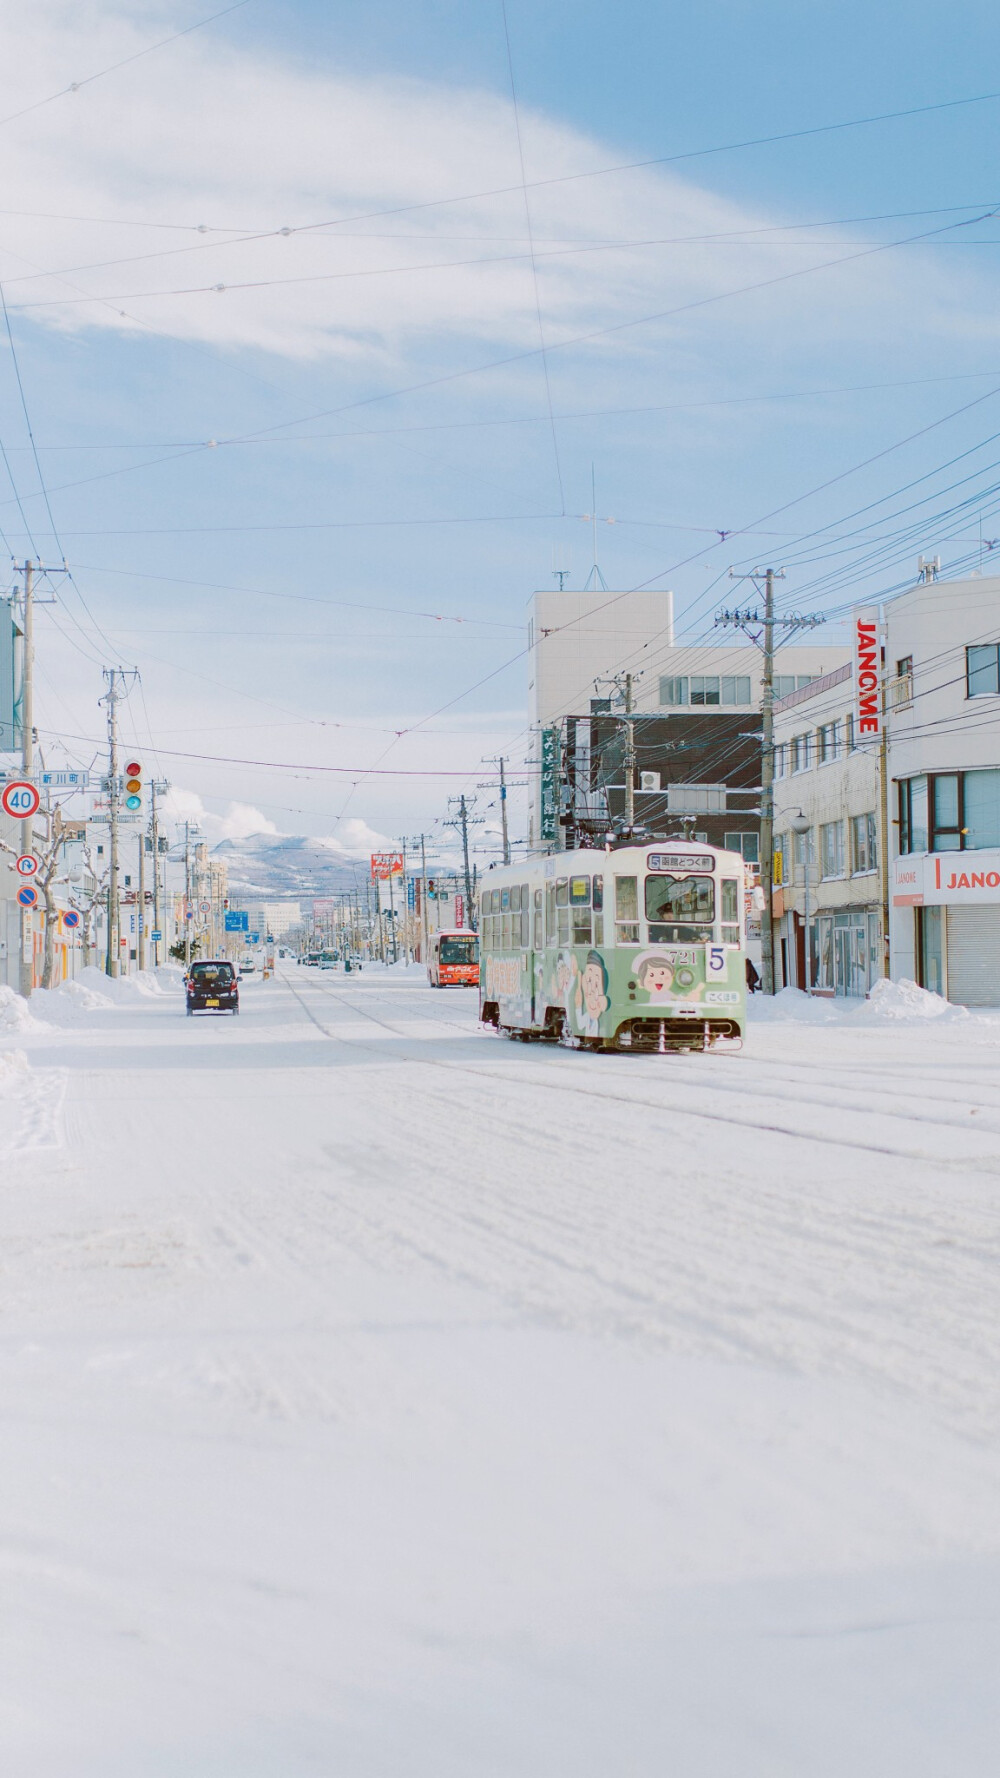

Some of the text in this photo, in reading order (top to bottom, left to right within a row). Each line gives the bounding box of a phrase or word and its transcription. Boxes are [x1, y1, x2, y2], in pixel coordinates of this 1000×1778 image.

[857, 618, 878, 733] JANOME
[10, 792, 31, 808] 40
[651, 856, 660, 868] 5
[897, 872, 916, 884] JANOME
[947, 872, 1000, 889] JANO
[669, 951, 696, 964] 721
[709, 948, 724, 971] 5
